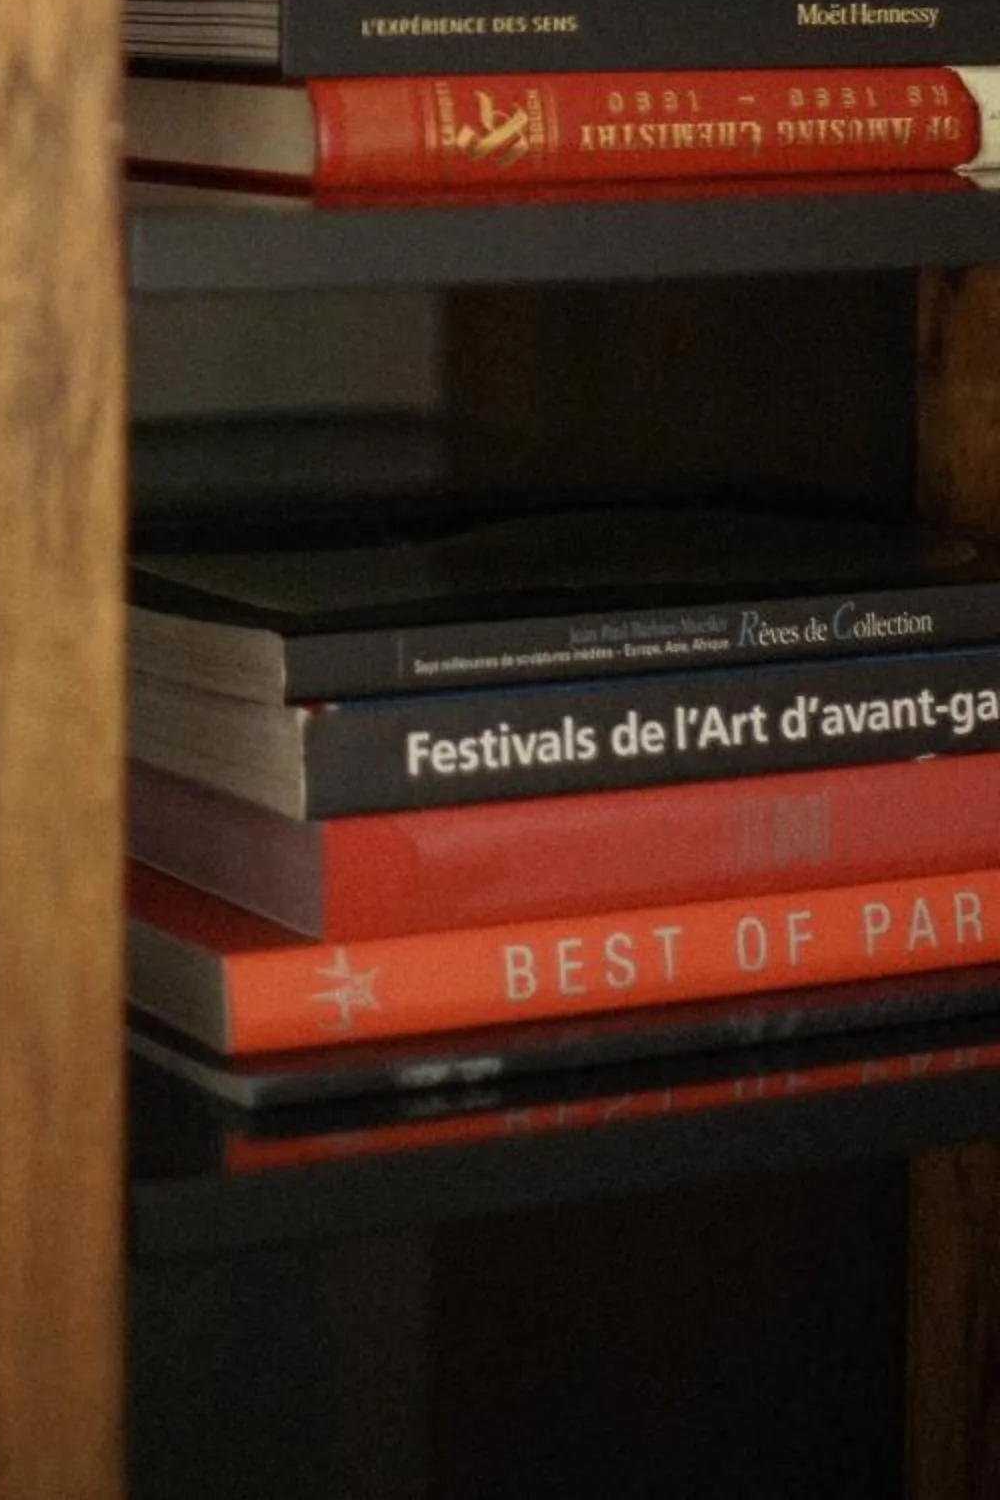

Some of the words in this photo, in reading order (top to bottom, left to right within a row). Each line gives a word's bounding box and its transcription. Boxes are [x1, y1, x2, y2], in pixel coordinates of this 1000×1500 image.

[361, 16, 487, 37] L'EXPÉRIENCE
[493, 16, 527, 35] DES
[532, 14, 580, 34] SENS
[797, 3, 849, 26] Moët
[850, 3, 940, 28] Hennessy
[804, 615, 829, 645] de
[832, 601, 934, 642] Collection
[407, 713, 597, 777] Festivals
[611, 709, 667, 758] de
[676, 705, 768, 750] l'Art
[505, 924, 684, 1001] BEST
[735, 910, 814, 973] OF
[862, 890, 985, 957] PAR
